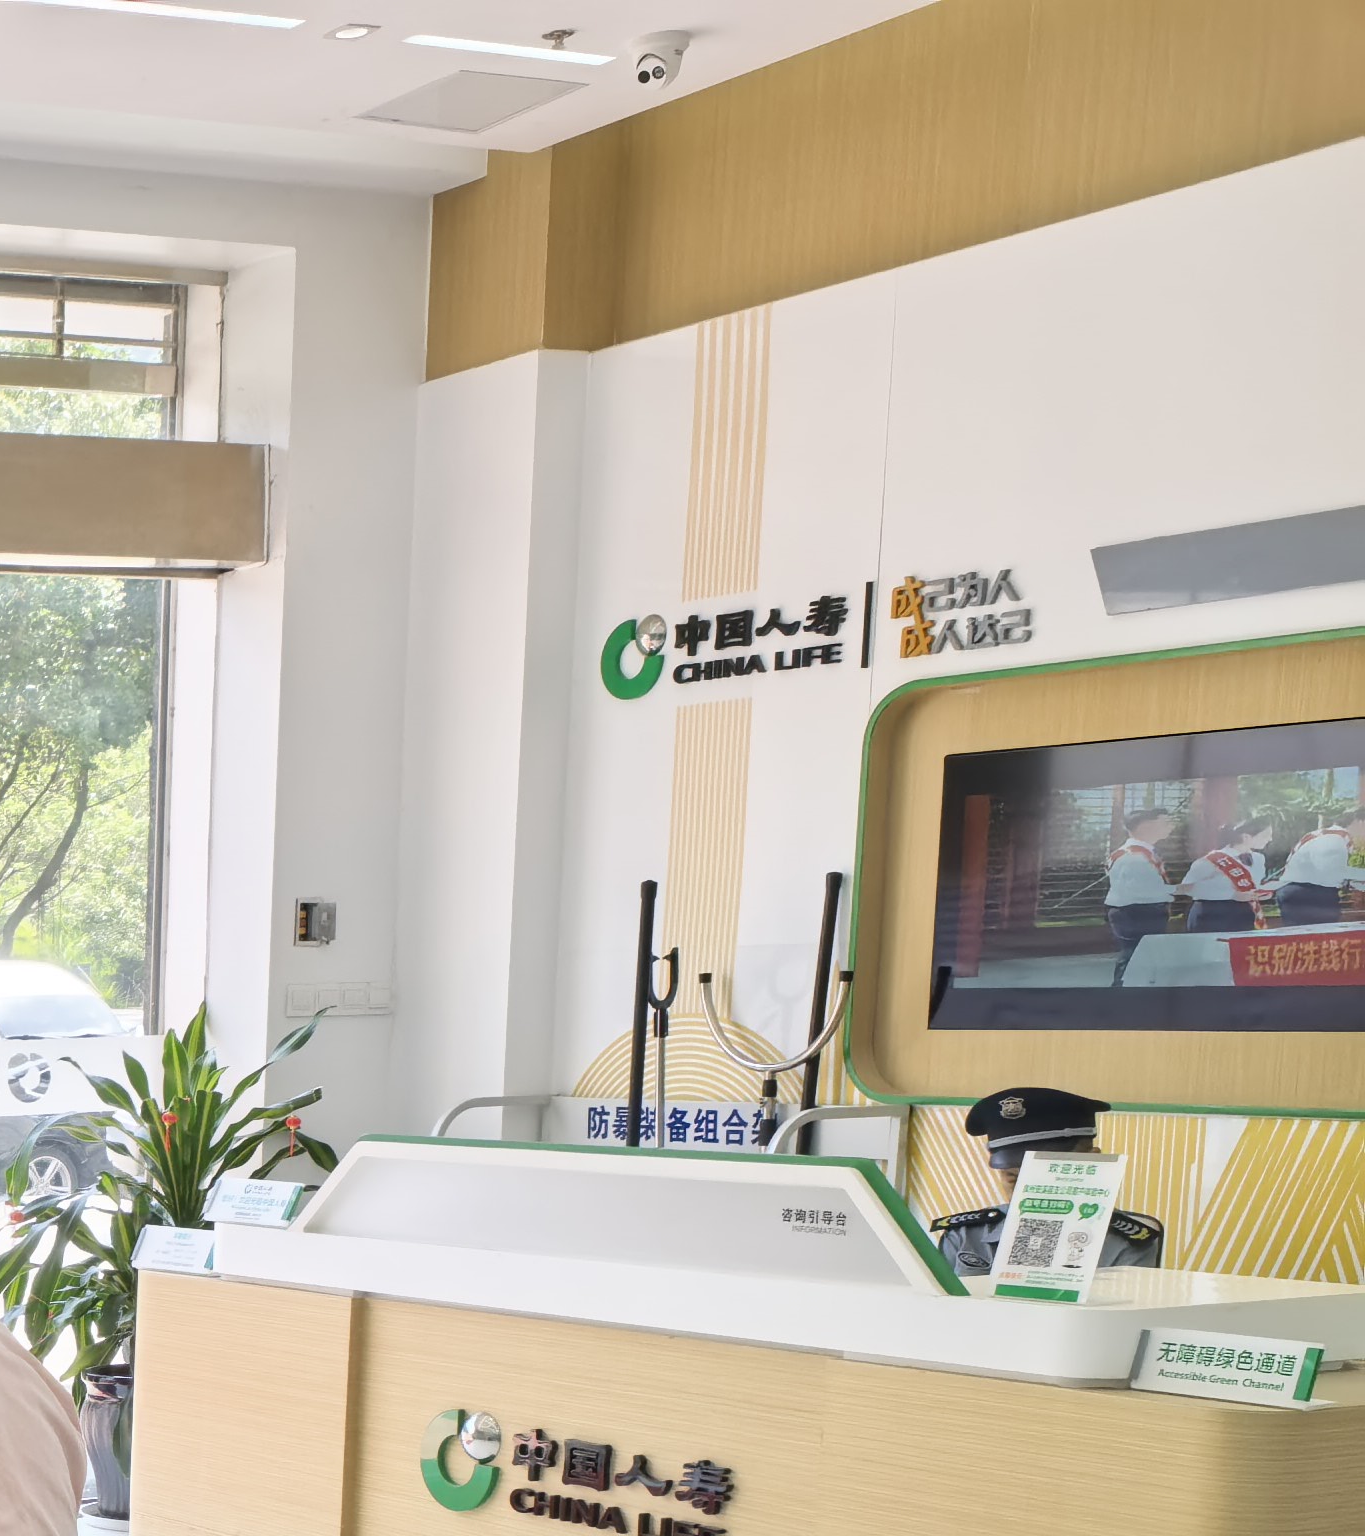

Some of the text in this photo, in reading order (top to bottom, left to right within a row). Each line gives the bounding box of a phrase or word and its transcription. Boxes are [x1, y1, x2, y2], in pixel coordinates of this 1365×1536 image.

[890, 568, 1023, 619] 成己为人
[674, 593, 848, 657] 中国人寿
[899, 608, 1033, 659] 成人达己
[672, 642, 844, 685] CHINA LIFE
[1245, 937, 1362, 977] 识别洗钱行
[781, 1207, 847, 1226] 咨询引导台
[791, 1225, 847, 1236] INFORMATION
[1157, 1341, 1297, 1377] 无障碍绿色通道
[1158, 1368, 1285, 1392] Accessible Green Channel
[512, 1428, 735, 1515] 中国人寿
[509, 1487, 629, 1535] CHINA
